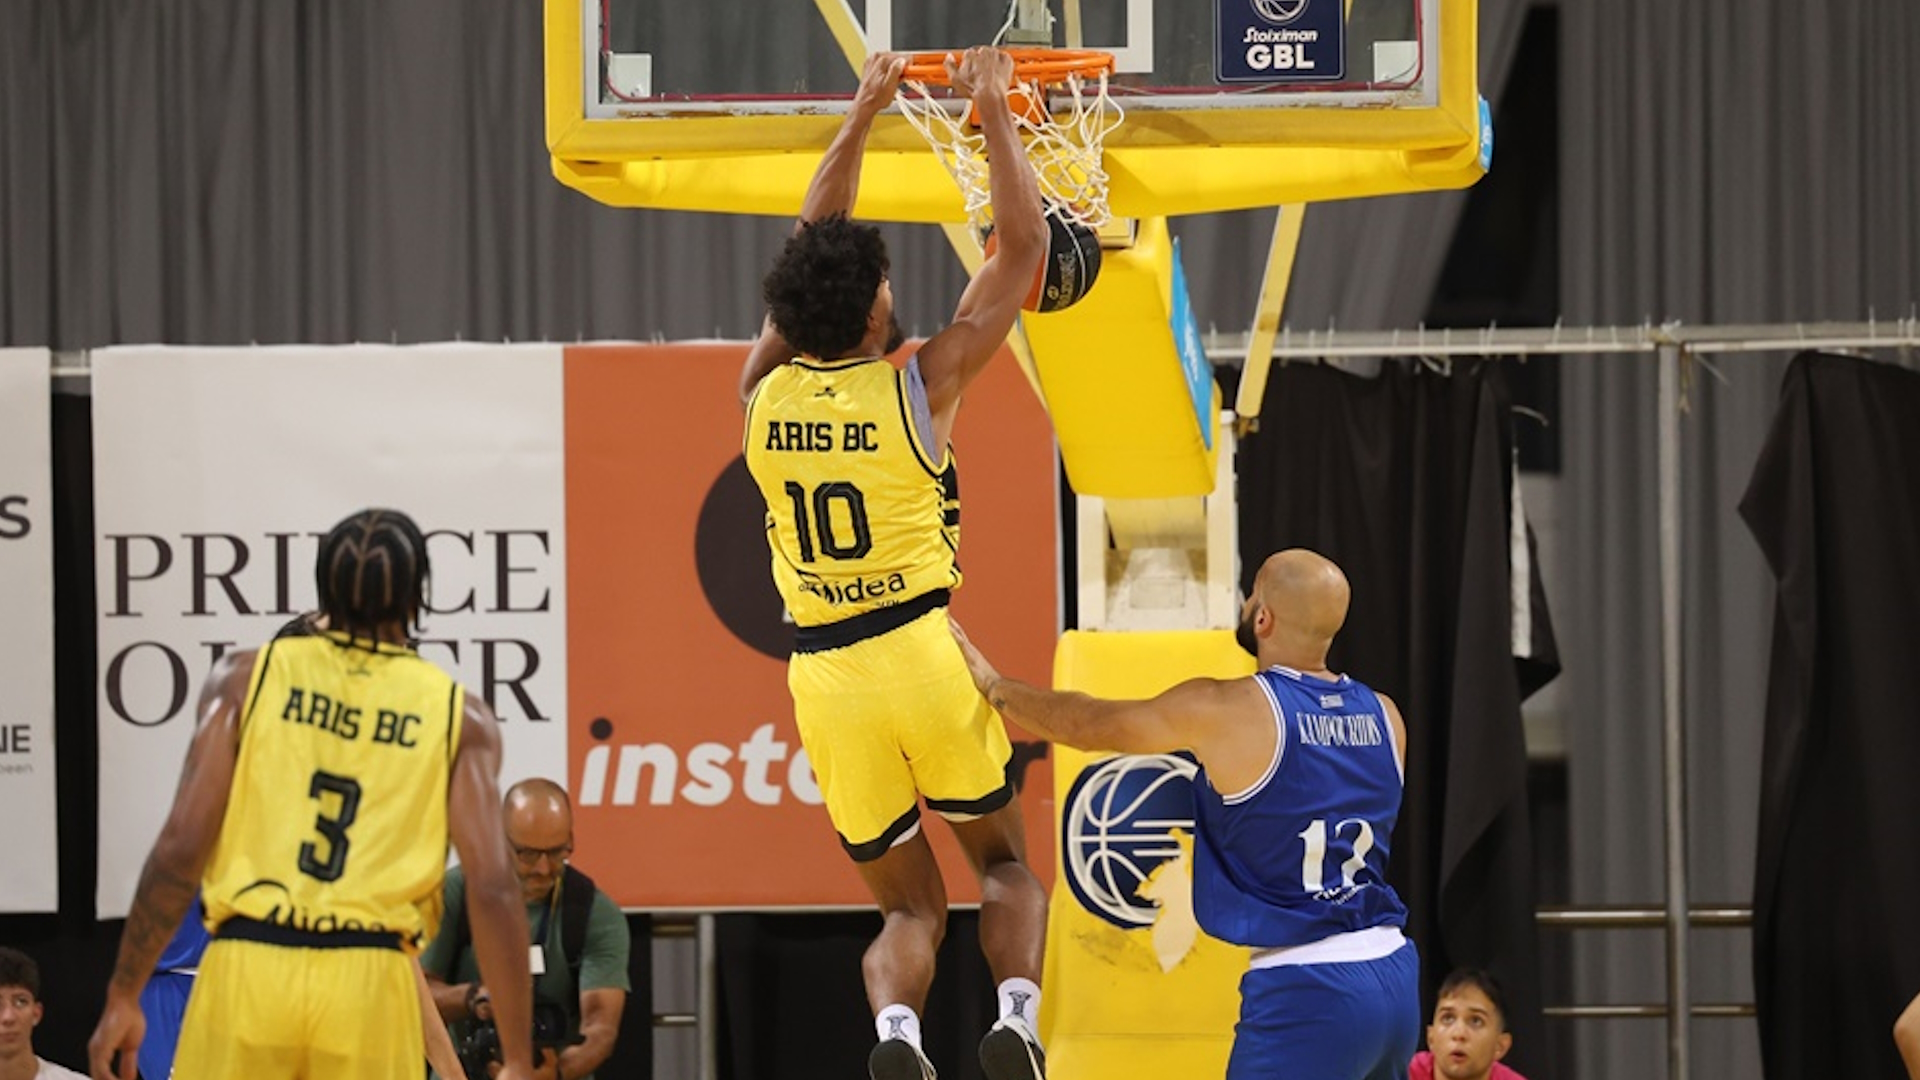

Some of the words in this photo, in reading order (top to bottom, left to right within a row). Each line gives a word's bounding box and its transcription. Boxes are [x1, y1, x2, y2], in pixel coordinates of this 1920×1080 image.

[1243, 26, 1319, 43] Stoiximan
[1246, 43, 1315, 70] GBL
[766, 421, 832, 451] ARIS
[843, 422, 879, 451] BC
[784, 481, 872, 563] 10
[105, 529, 550, 616] PRICE
[282, 687, 362, 740] ARIS
[372, 709, 422, 748] BC
[298, 768, 362, 883] 3
[1298, 818, 1374, 893] 12
